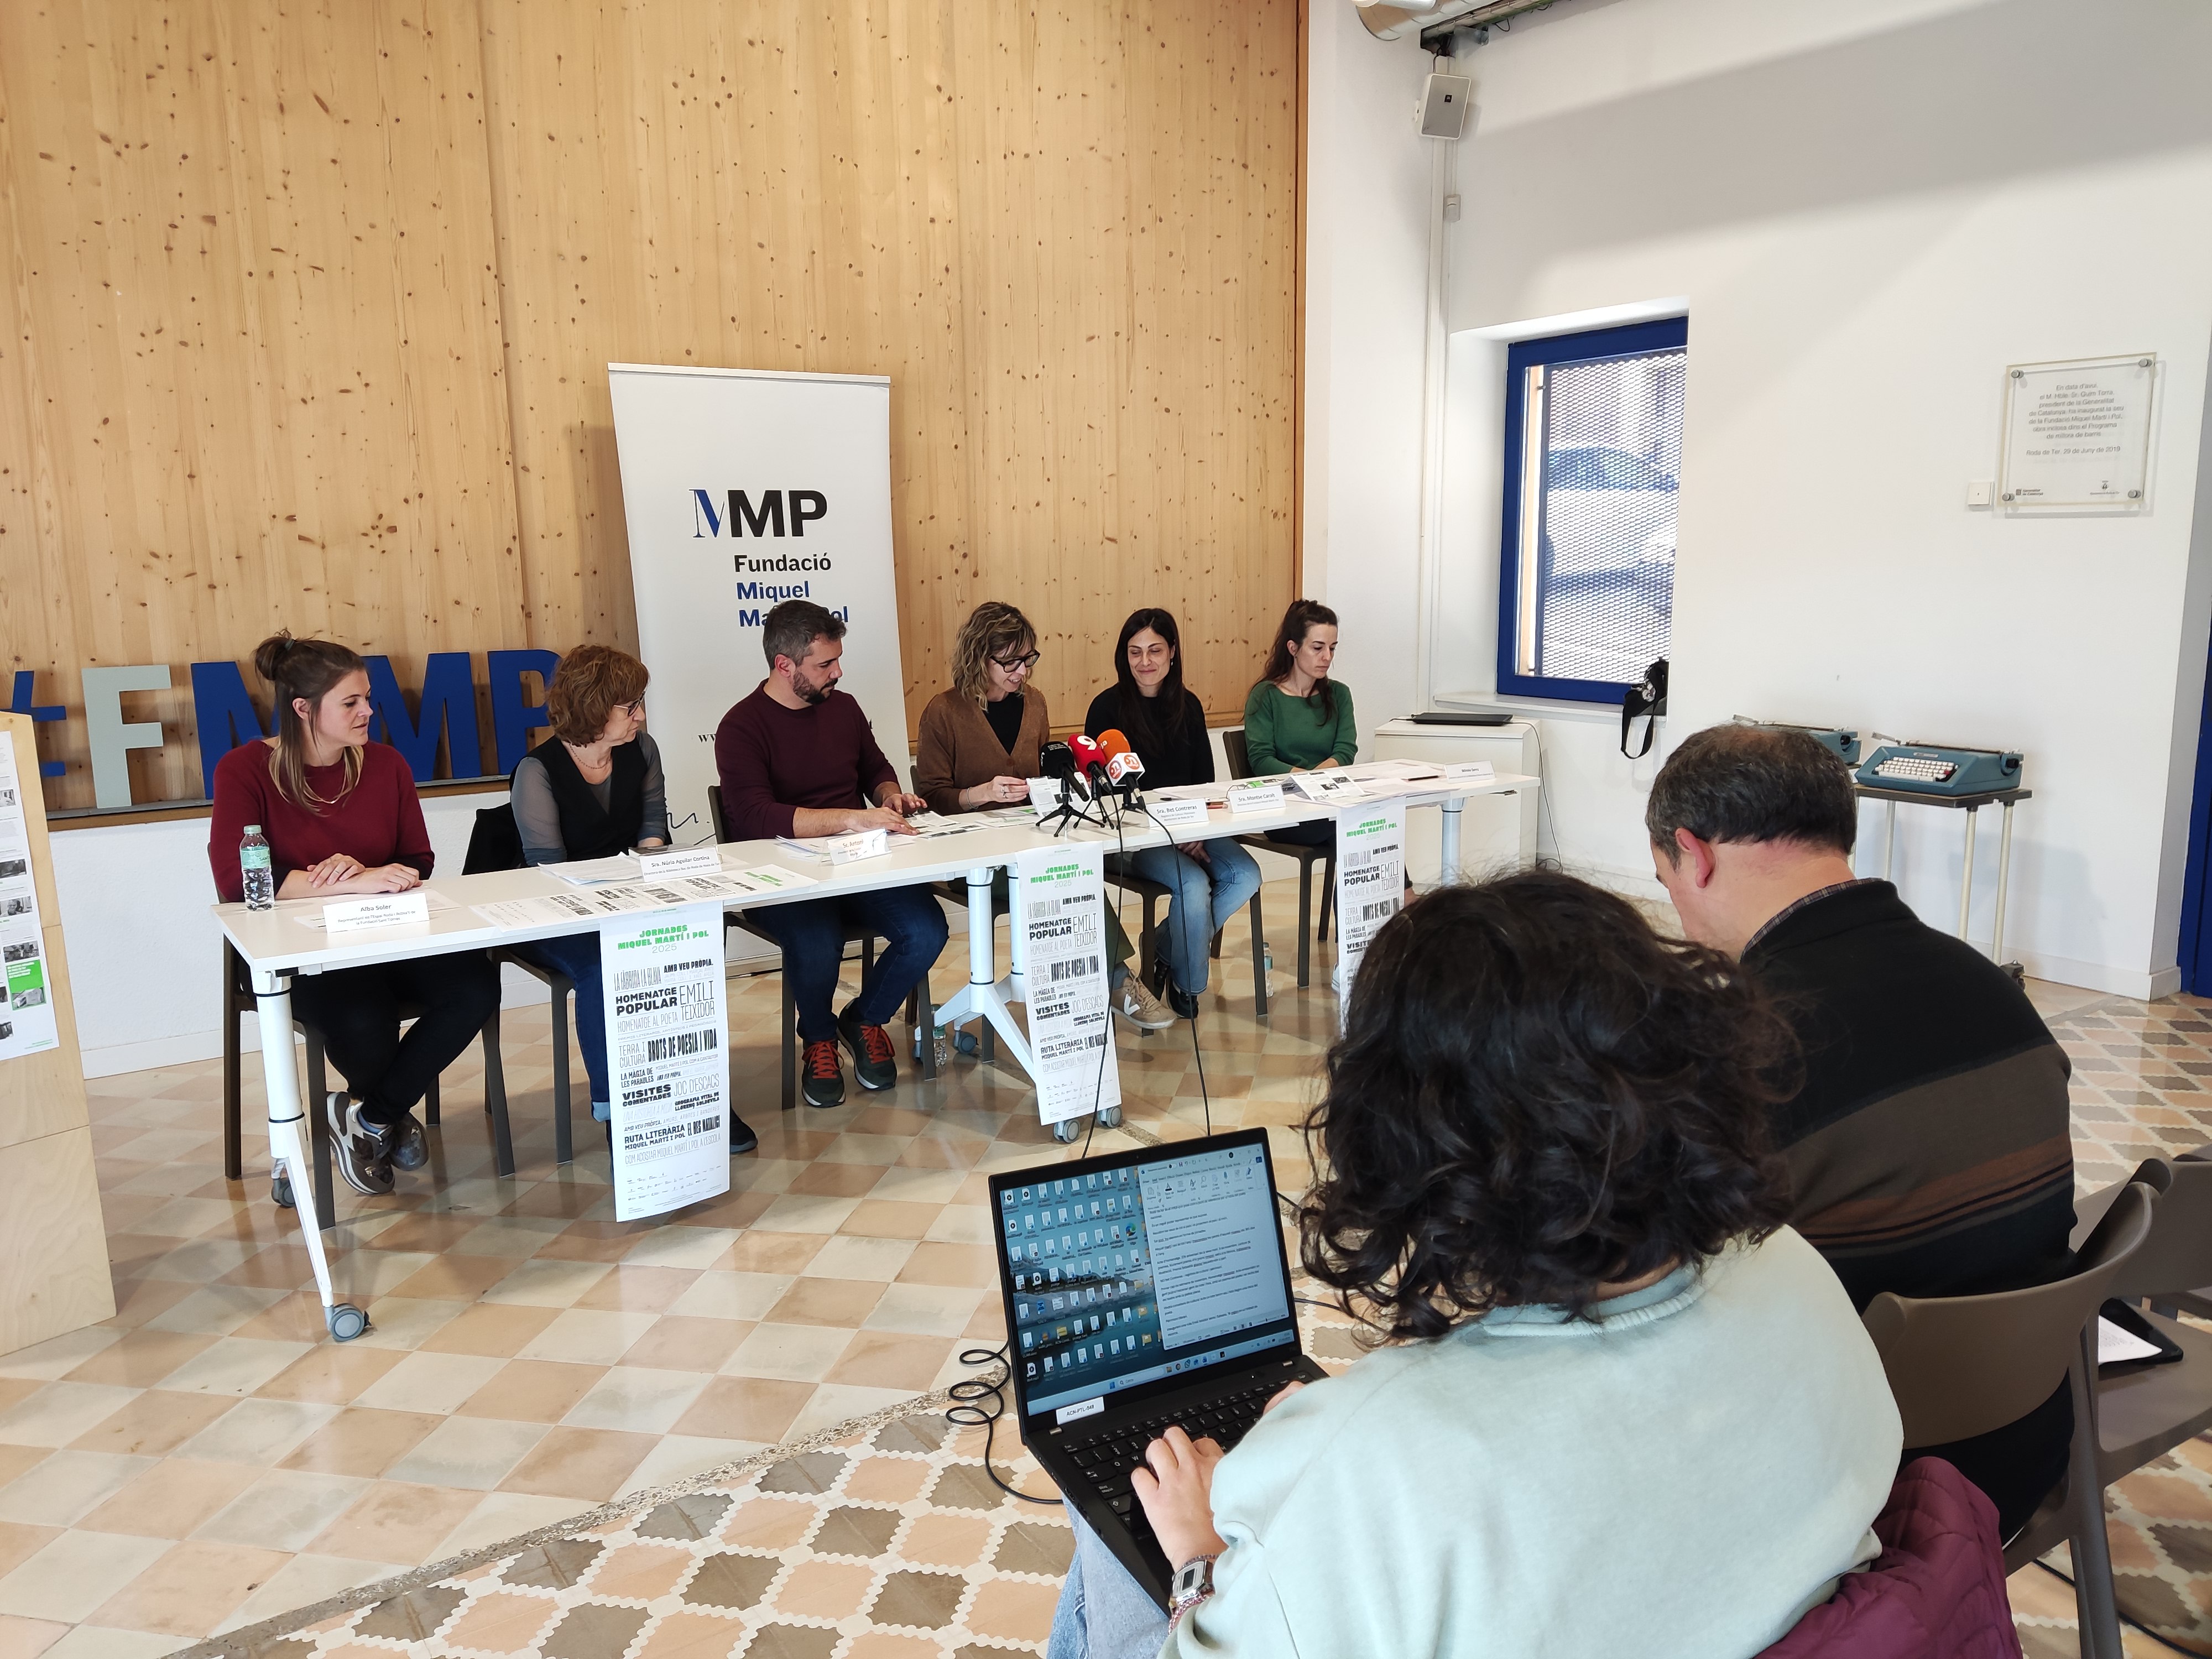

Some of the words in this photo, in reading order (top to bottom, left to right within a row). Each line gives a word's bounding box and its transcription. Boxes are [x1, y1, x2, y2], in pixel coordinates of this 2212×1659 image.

[734, 552, 832, 572] Fundació
[736, 581, 810, 603] Miquel
[1359, 818, 1386, 828] JORNADES
[1031, 875, 1054, 883] MIQUEL
[1057, 870, 1076, 880] MARTÍ
[1046, 864, 1079, 874] JORNADES
[1344, 865, 1380, 878] HOMENATGE
[1381, 860, 1399, 879] EMILI
[1344, 873, 1380, 886] POPULAR
[1029, 918, 1071, 930] HOMENATGE
[1073, 913, 1097, 933] EMILI
[639, 925, 687, 937] JORNADES
[1030, 926, 1072, 941] POPULAR
[618, 939, 652, 950] MIQUEL
[655, 932, 684, 944] MARTÍ
[692, 930, 709, 938] POL
[1074, 931, 1097, 947] TEIXIDOR
[652, 943, 677, 953] 2025
[664, 964, 677, 973] AMB
[679, 962, 690, 971] VEU
[615, 987, 677, 1004] HOMENATGE
[680, 980, 714, 1005] EMILI
[616, 997, 677, 1016] POPULAR
[681, 1000, 714, 1021] TEIXIDOR
[1036, 1003, 1069, 1015] VISITES
[618, 1016, 651, 1032] HOMENATGE
[653, 1015, 659, 1026] AL
[661, 1012, 678, 1025] POETA
[619, 1042, 640, 1056] TERRA
[648, 1037, 667, 1062] BROTS
[669, 1036, 676, 1058] DE
[703, 1028, 717, 1051] VIDA
[1041, 1045, 1055, 1054] RUTA
[1055, 1039, 1083, 1050] LITERÀRIA
[619, 1053, 646, 1068] CULTURA
[628, 1069, 645, 1078] MÀGIA
[631, 1076, 654, 1086] PARAULES
[622, 1084, 671, 1100] VISITES
[674, 1081, 687, 1097] JOC
[689, 1073, 719, 1093] D'ESCACS
[623, 1092, 671, 1107] COMENTADES
[624, 1134, 644, 1144] RUTA
[645, 1124, 685, 1140] LITERÀRIA
[625, 1141, 648, 1150] MIQUEL
[650, 1135, 669, 1145] MARTÍ
[625, 1156, 635, 1164] COM
[657, 1146, 673, 1157] MIQUEL
